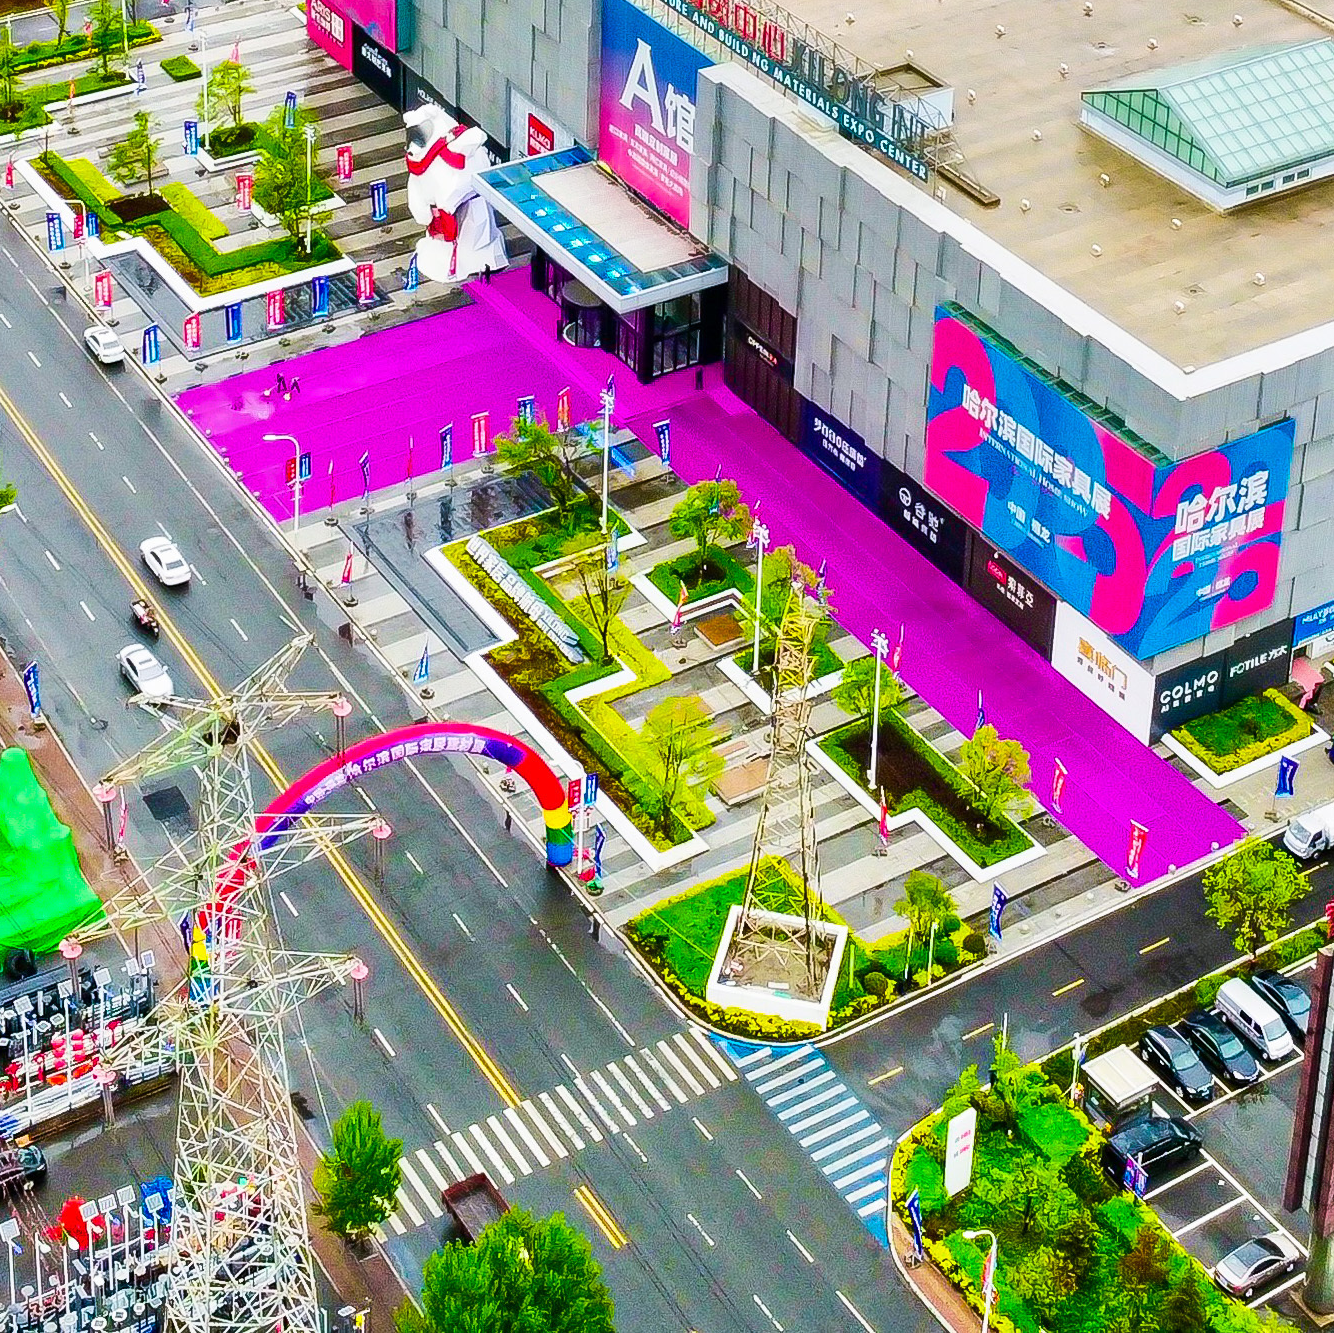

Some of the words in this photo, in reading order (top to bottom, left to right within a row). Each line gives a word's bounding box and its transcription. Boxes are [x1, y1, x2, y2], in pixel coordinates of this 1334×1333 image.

[619, 37, 697, 155] A馆
[692, 11, 715, 35] AND
[718, 30, 769, 72] BUILDNG
[773, 66, 839, 119] MATERIALS
[842, 113, 875, 144] EXPO
[879, 138, 927, 180] CENTER
[962, 383, 1112, 521] 哈尔滨国际家具展
[1172, 506, 1266, 562] 国际家具展
[1174, 469, 1270, 535] 哈尔滨
[1159, 669, 1219, 705] COLMO
[1230, 652, 1268, 678] FOTILE
